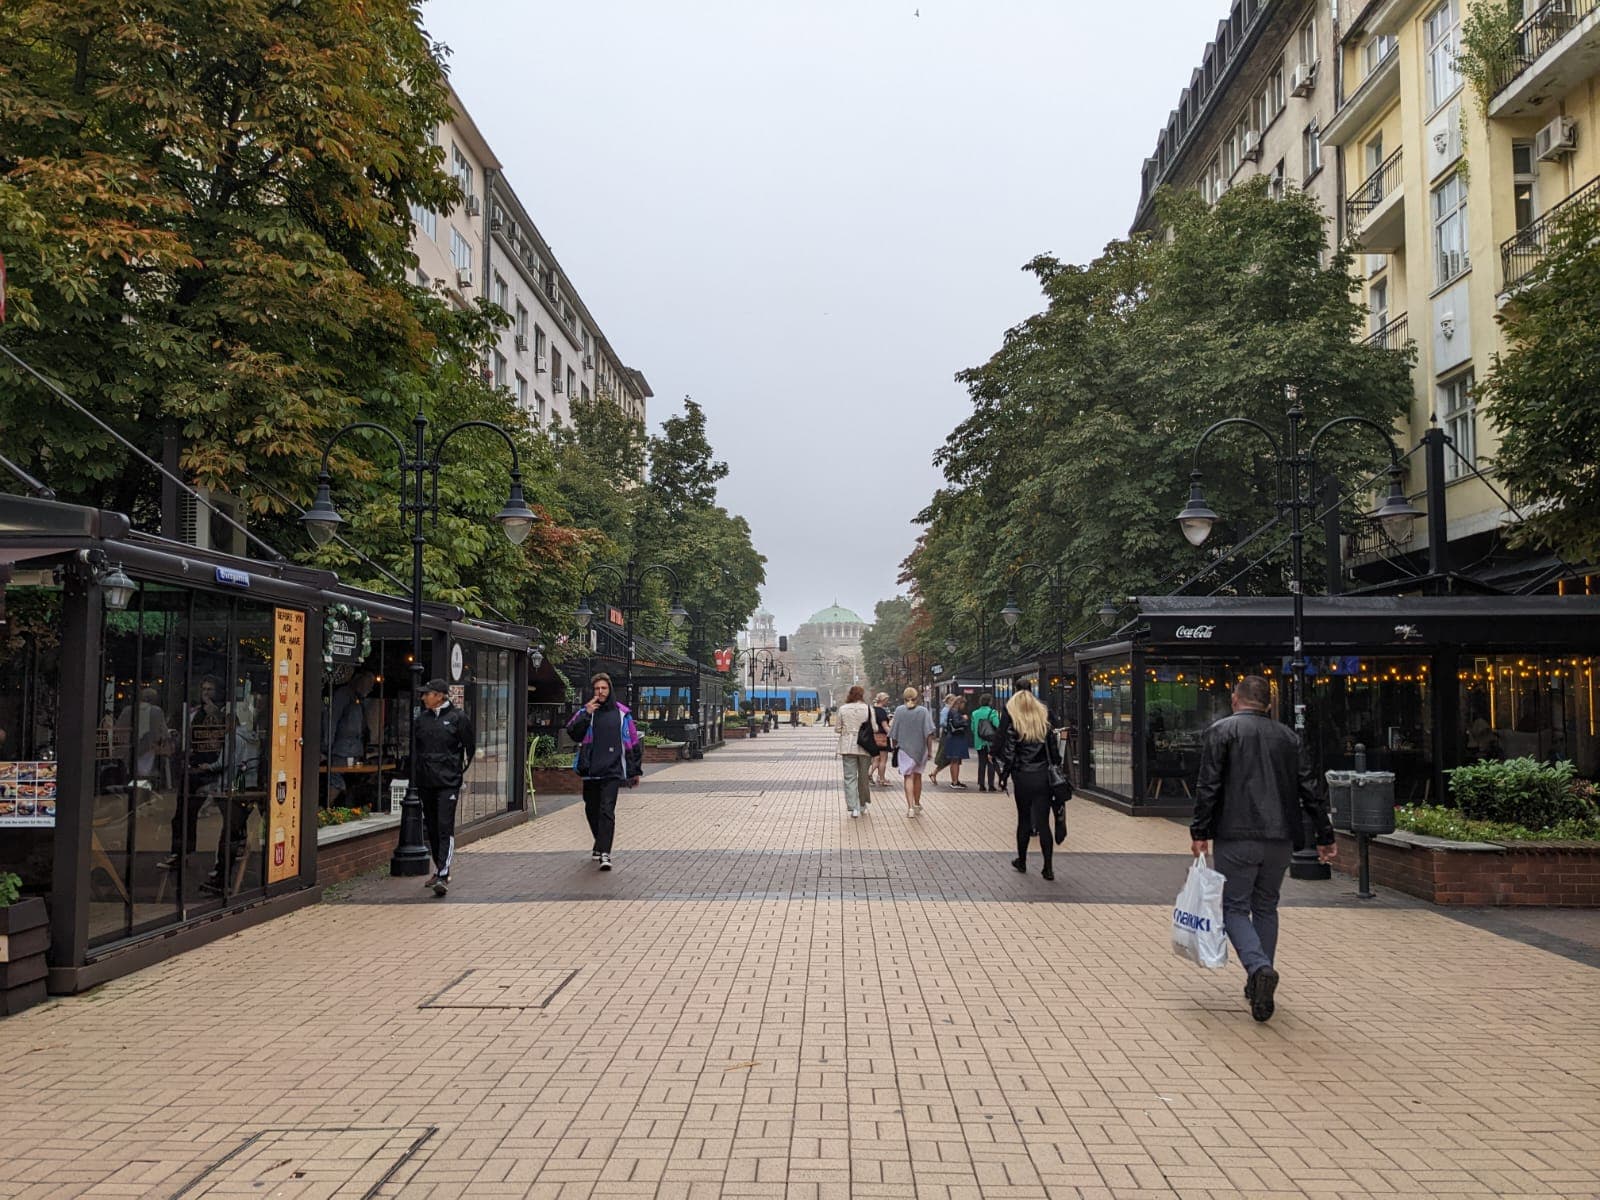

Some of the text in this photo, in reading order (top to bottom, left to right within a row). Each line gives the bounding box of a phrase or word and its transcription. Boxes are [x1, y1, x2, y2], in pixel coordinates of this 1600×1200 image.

[283, 624, 292, 633] ASK
[1175, 625, 1216, 639] Coca-Cola
[279, 635, 286, 644] WE
